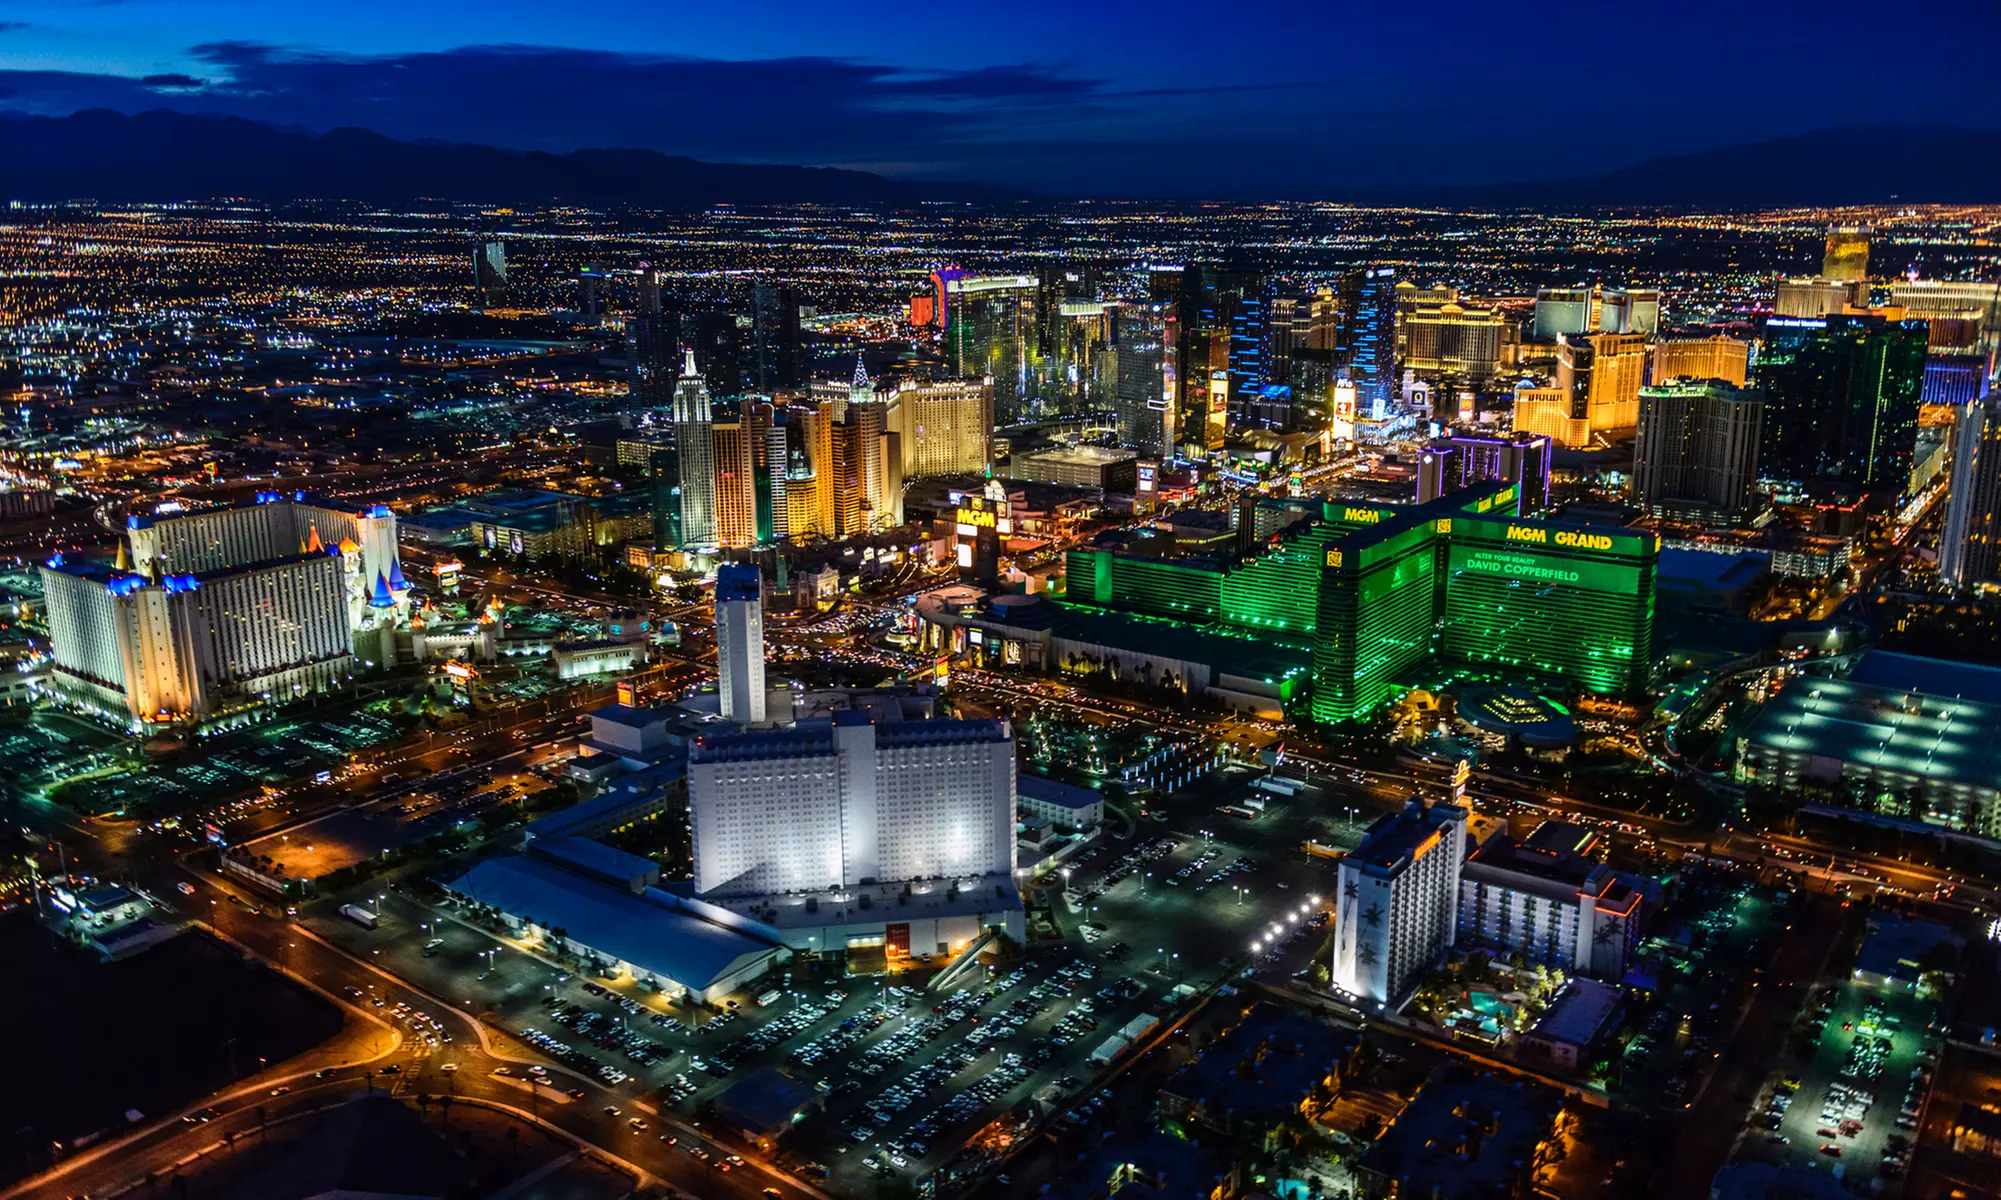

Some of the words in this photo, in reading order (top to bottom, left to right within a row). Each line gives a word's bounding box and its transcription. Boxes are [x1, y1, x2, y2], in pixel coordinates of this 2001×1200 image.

[957, 508, 995, 528] MGM
[1344, 507, 1379, 523] MGM
[1506, 525, 1546, 543] MGM
[1555, 531, 1612, 550] GRAND
[1474, 552, 1492, 560] ALTER
[1493, 554, 1510, 562] YOUR
[1511, 556, 1536, 565] REALITY
[1467, 559, 1501, 572] DAVID
[1504, 563, 1579, 582] COPPERFIELD
